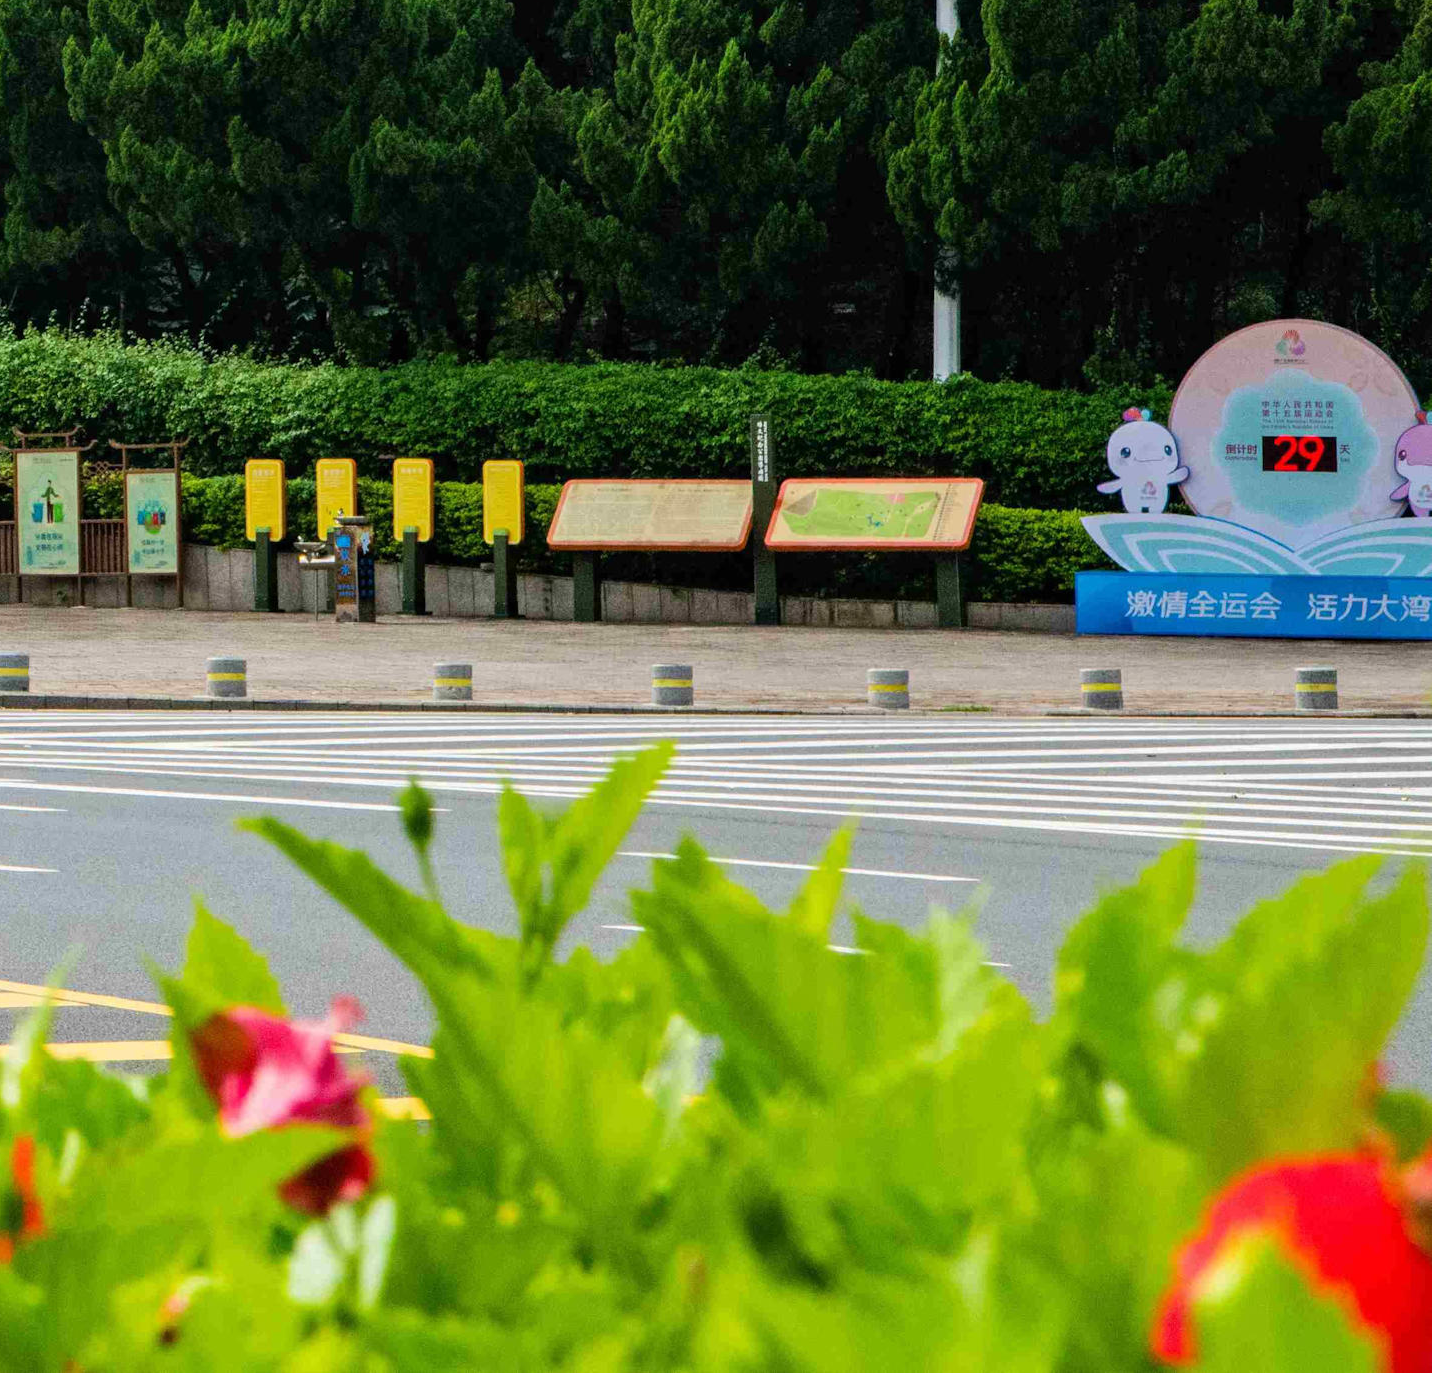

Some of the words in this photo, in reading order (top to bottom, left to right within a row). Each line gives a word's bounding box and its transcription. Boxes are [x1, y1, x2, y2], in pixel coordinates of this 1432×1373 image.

[1274, 434, 1325, 471] 29
[1124, 590, 1283, 621] 激情全运会
[1306, 593, 1432, 623] 活力大湾
